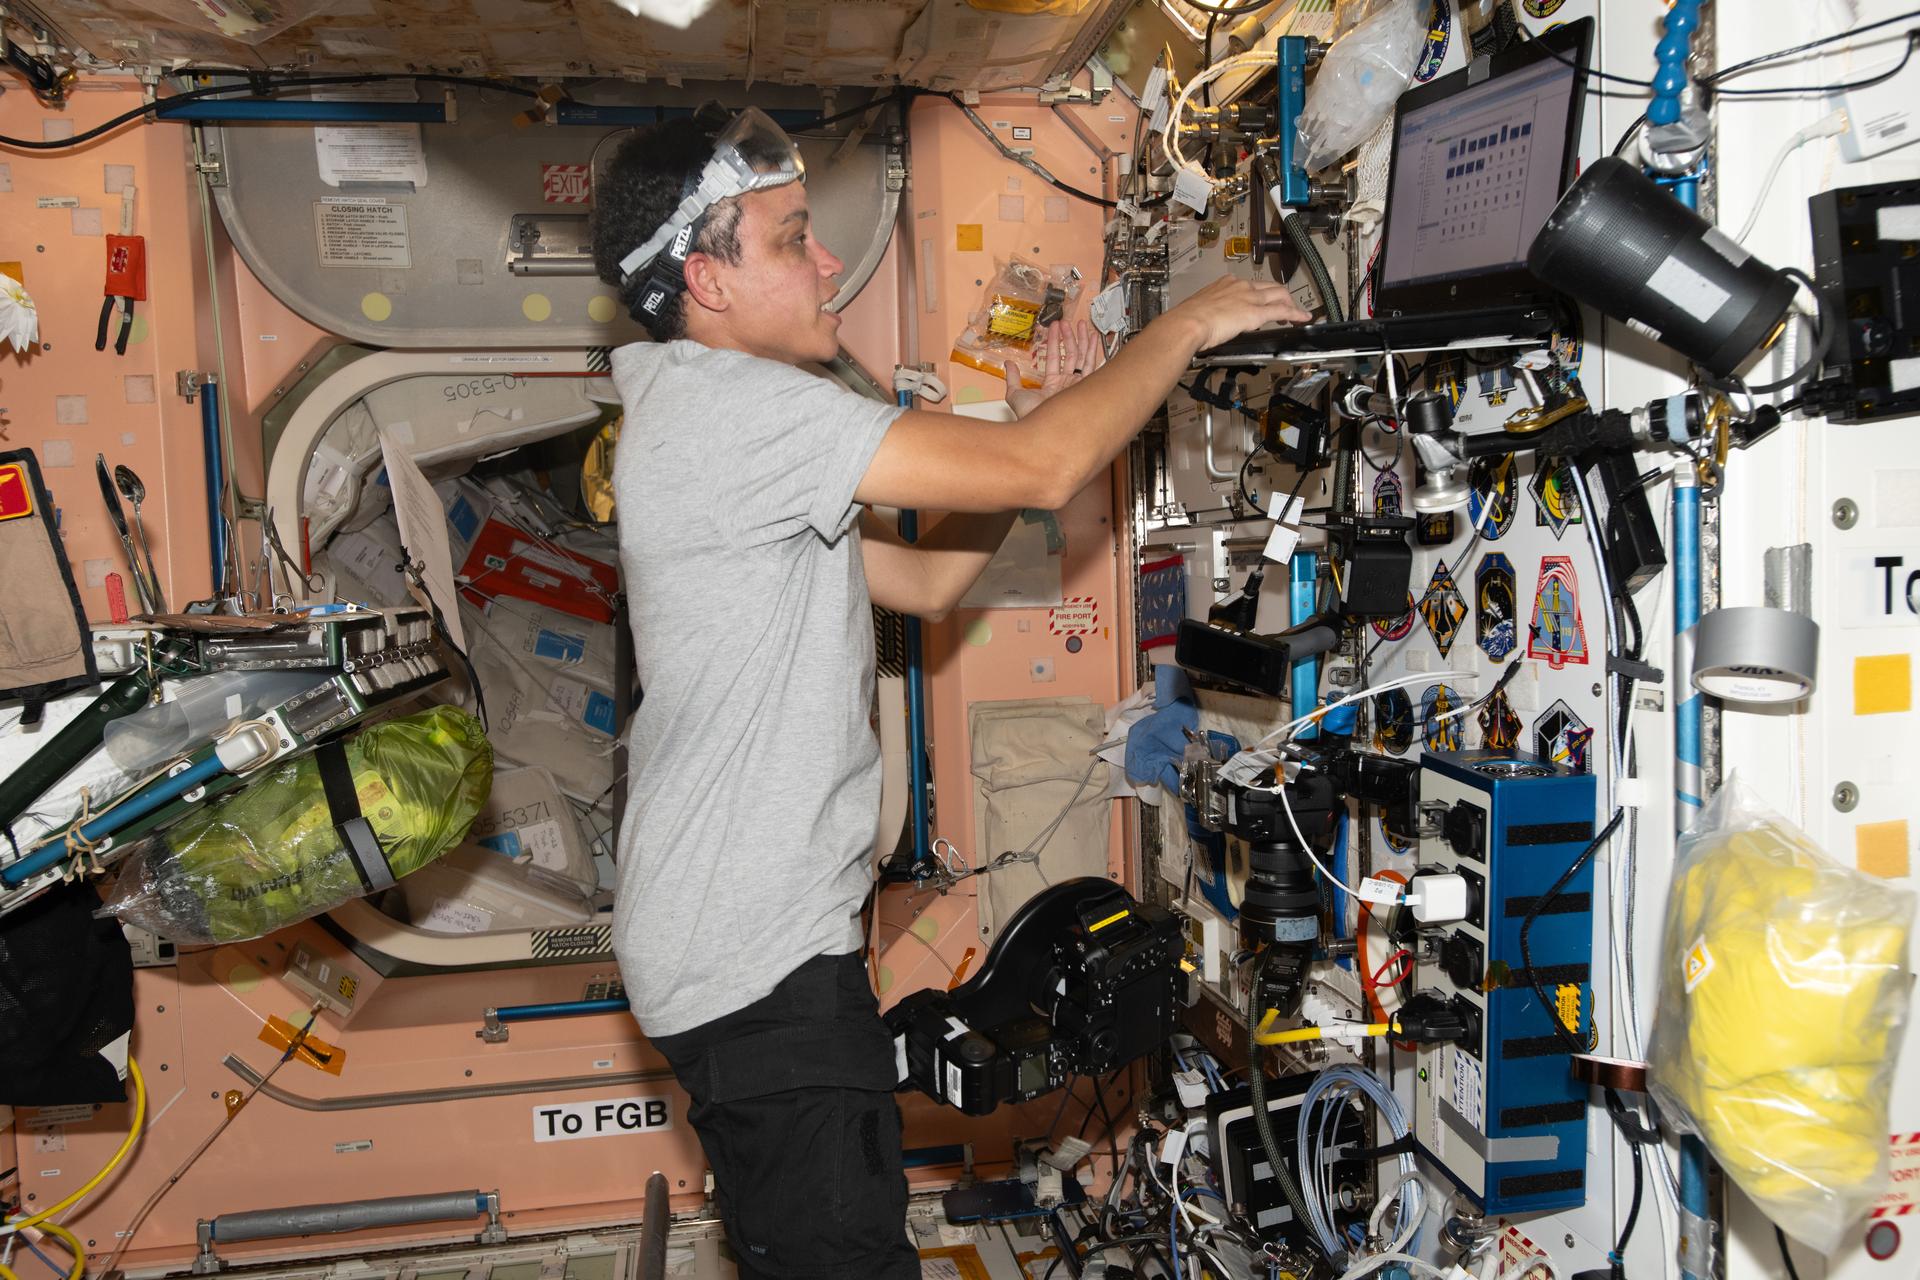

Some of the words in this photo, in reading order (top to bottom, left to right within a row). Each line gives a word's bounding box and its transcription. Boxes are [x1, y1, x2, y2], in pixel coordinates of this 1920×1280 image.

[550, 174, 583, 194] EXIT
[366, 206, 393, 214] HATCH
[670, 224, 692, 260] PETZL
[642, 292, 665, 316] PETZL
[443, 373, 527, 402] 10-5305
[540, 1109, 584, 1138] To
[594, 1100, 668, 1133] FGB
[1505, 1234, 1532, 1257] EMERGENC
